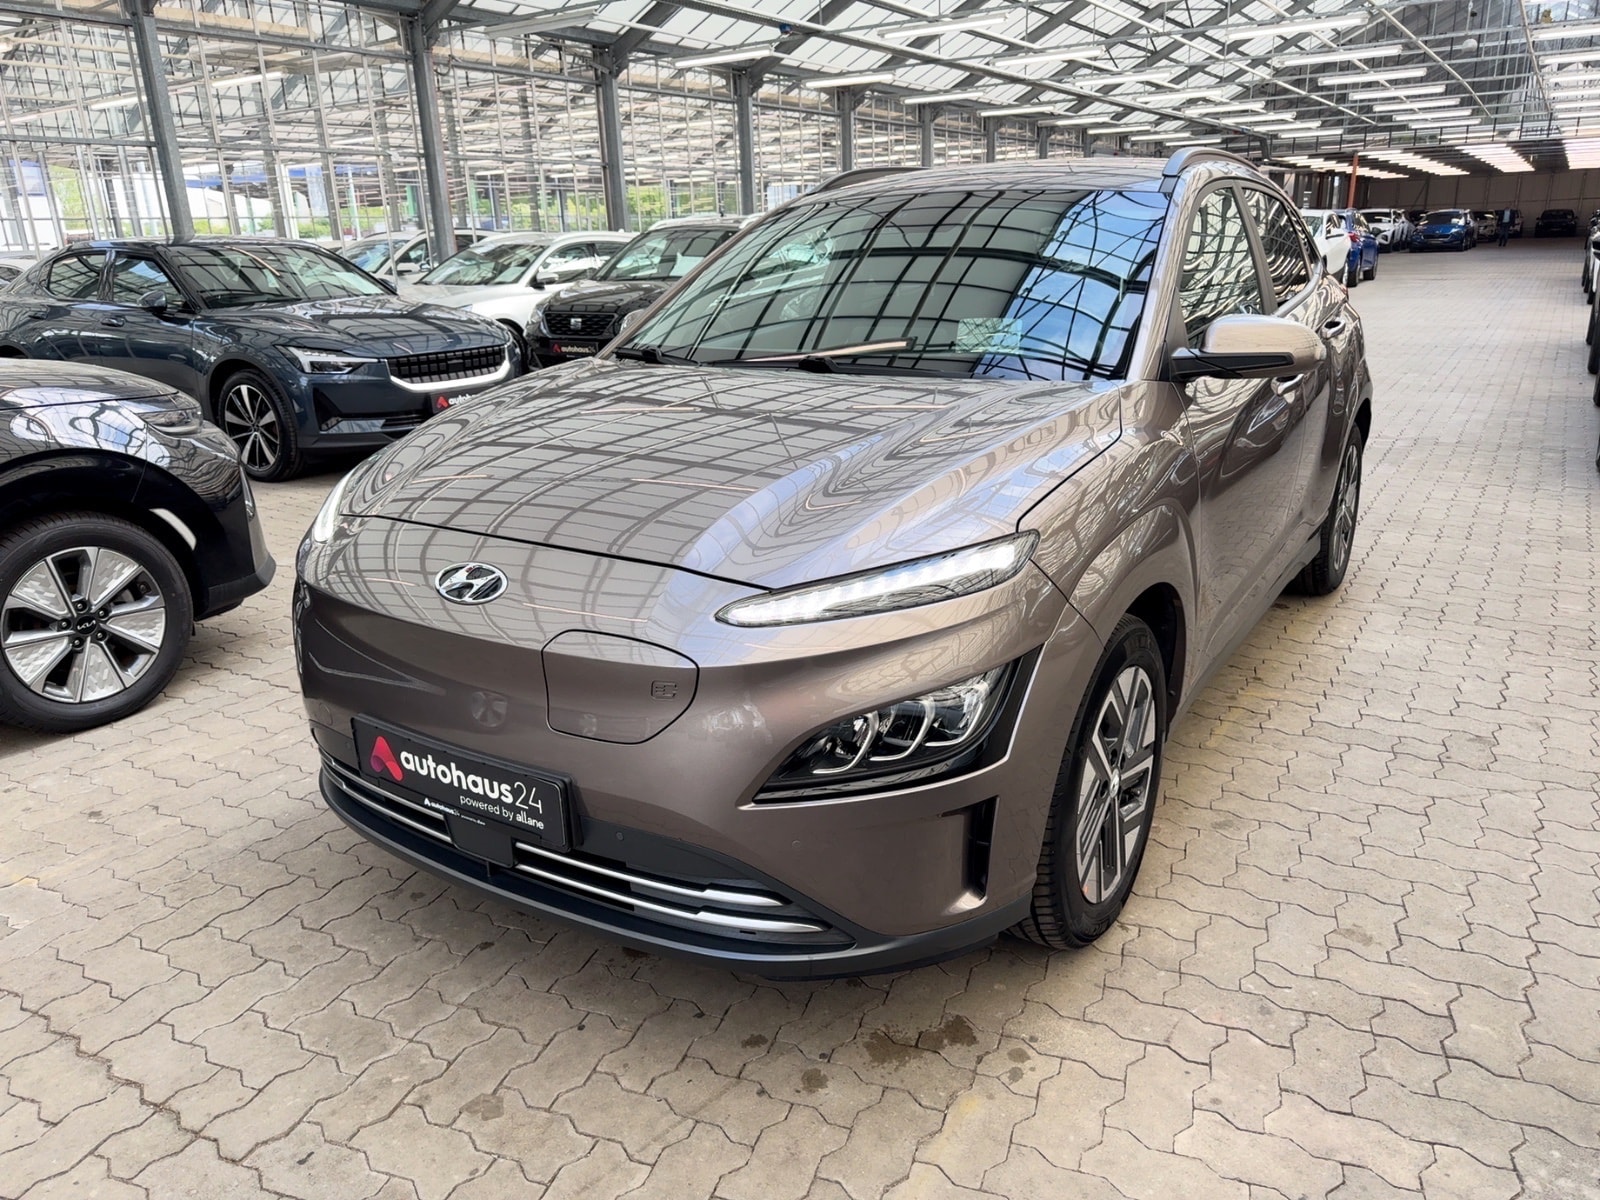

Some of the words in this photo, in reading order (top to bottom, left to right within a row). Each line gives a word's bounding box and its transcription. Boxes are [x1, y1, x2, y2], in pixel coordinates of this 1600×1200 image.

[400, 750, 543, 814] autohaus24
[460, 795, 500, 815] powered
[502, 806, 514, 822] by
[515, 813, 545, 830] allane
